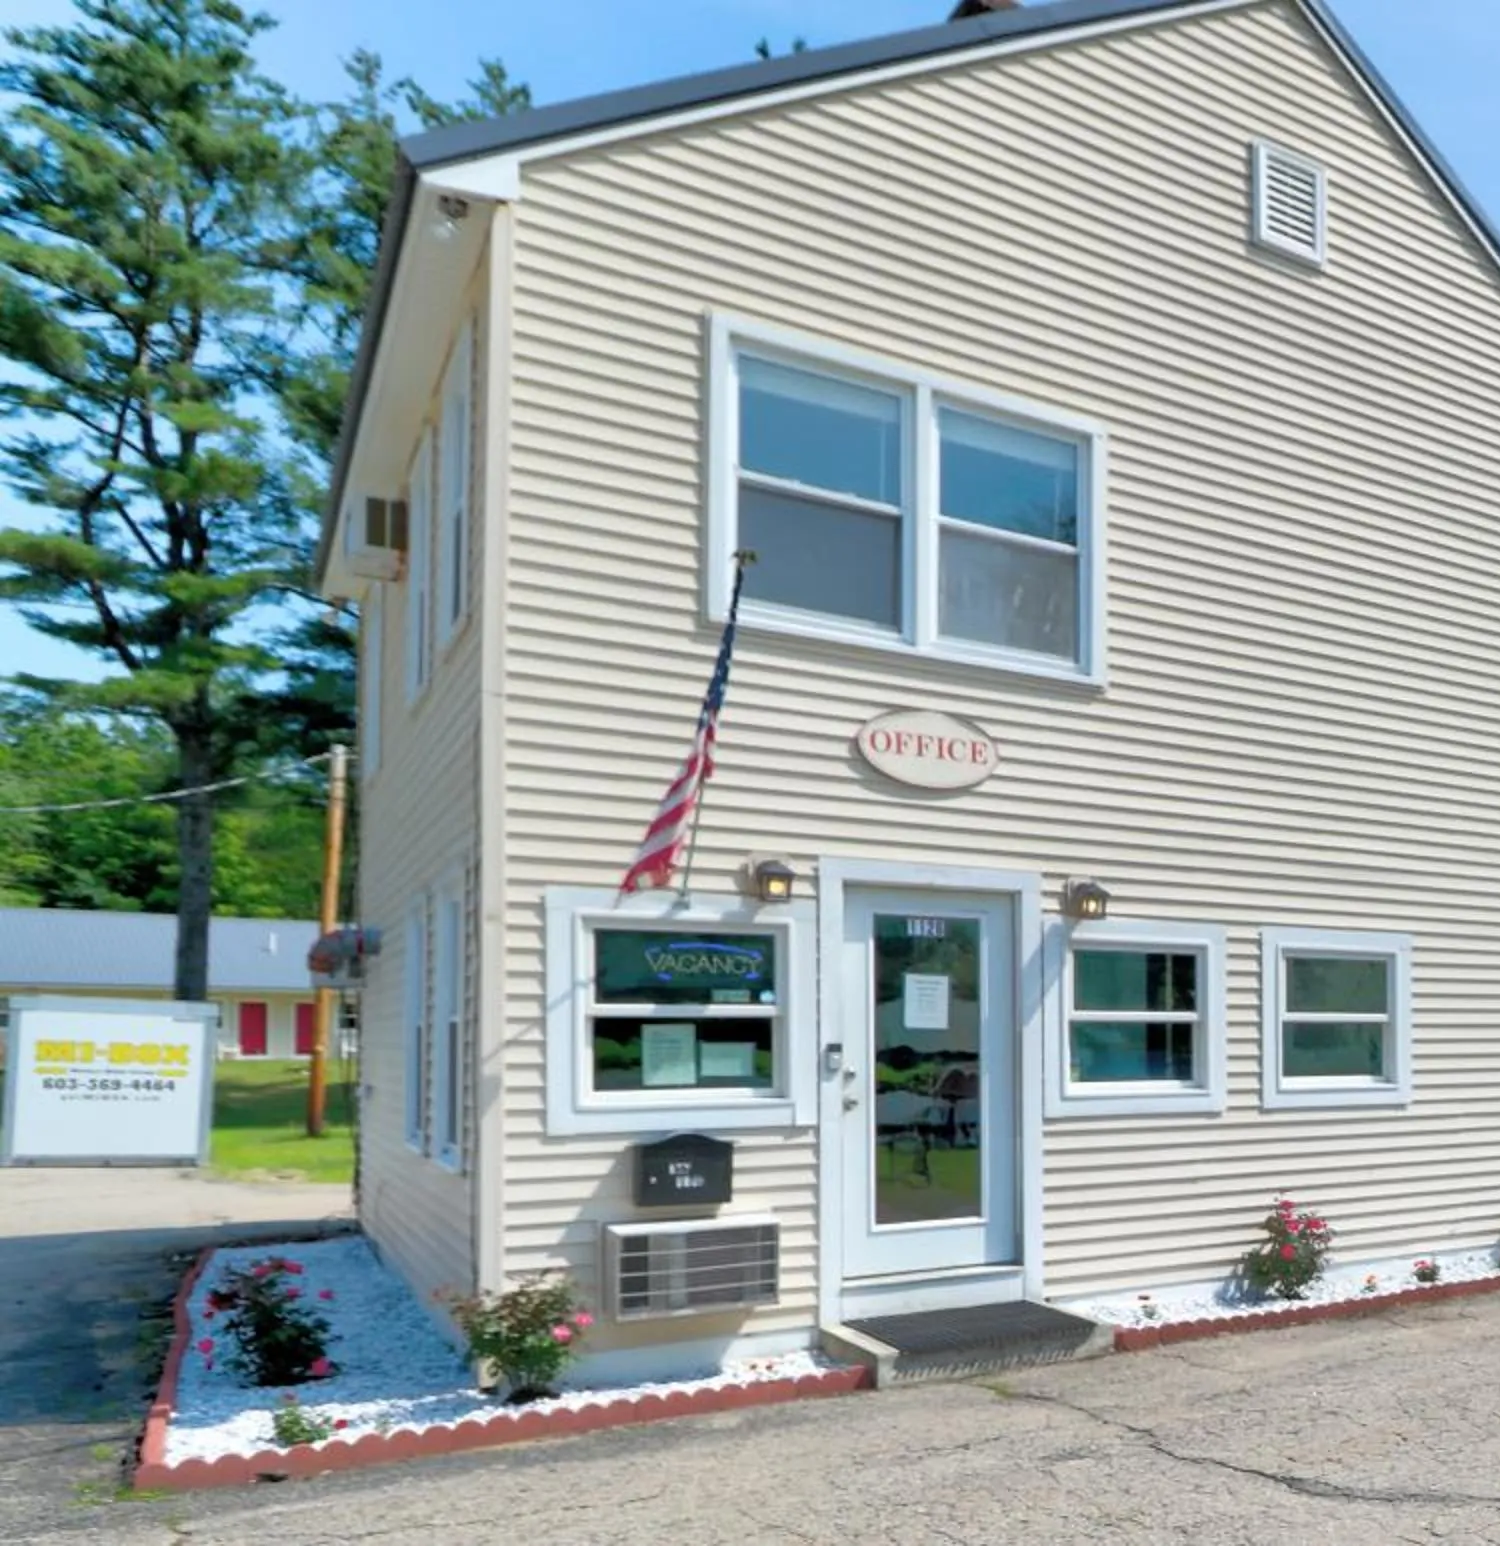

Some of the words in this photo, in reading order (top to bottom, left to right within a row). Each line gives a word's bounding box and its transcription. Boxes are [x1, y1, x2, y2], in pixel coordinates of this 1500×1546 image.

[869, 730, 988, 765] OFFICE
[645, 947, 761, 975] VACANCY
[35, 1040, 190, 1066] MI-BOX
